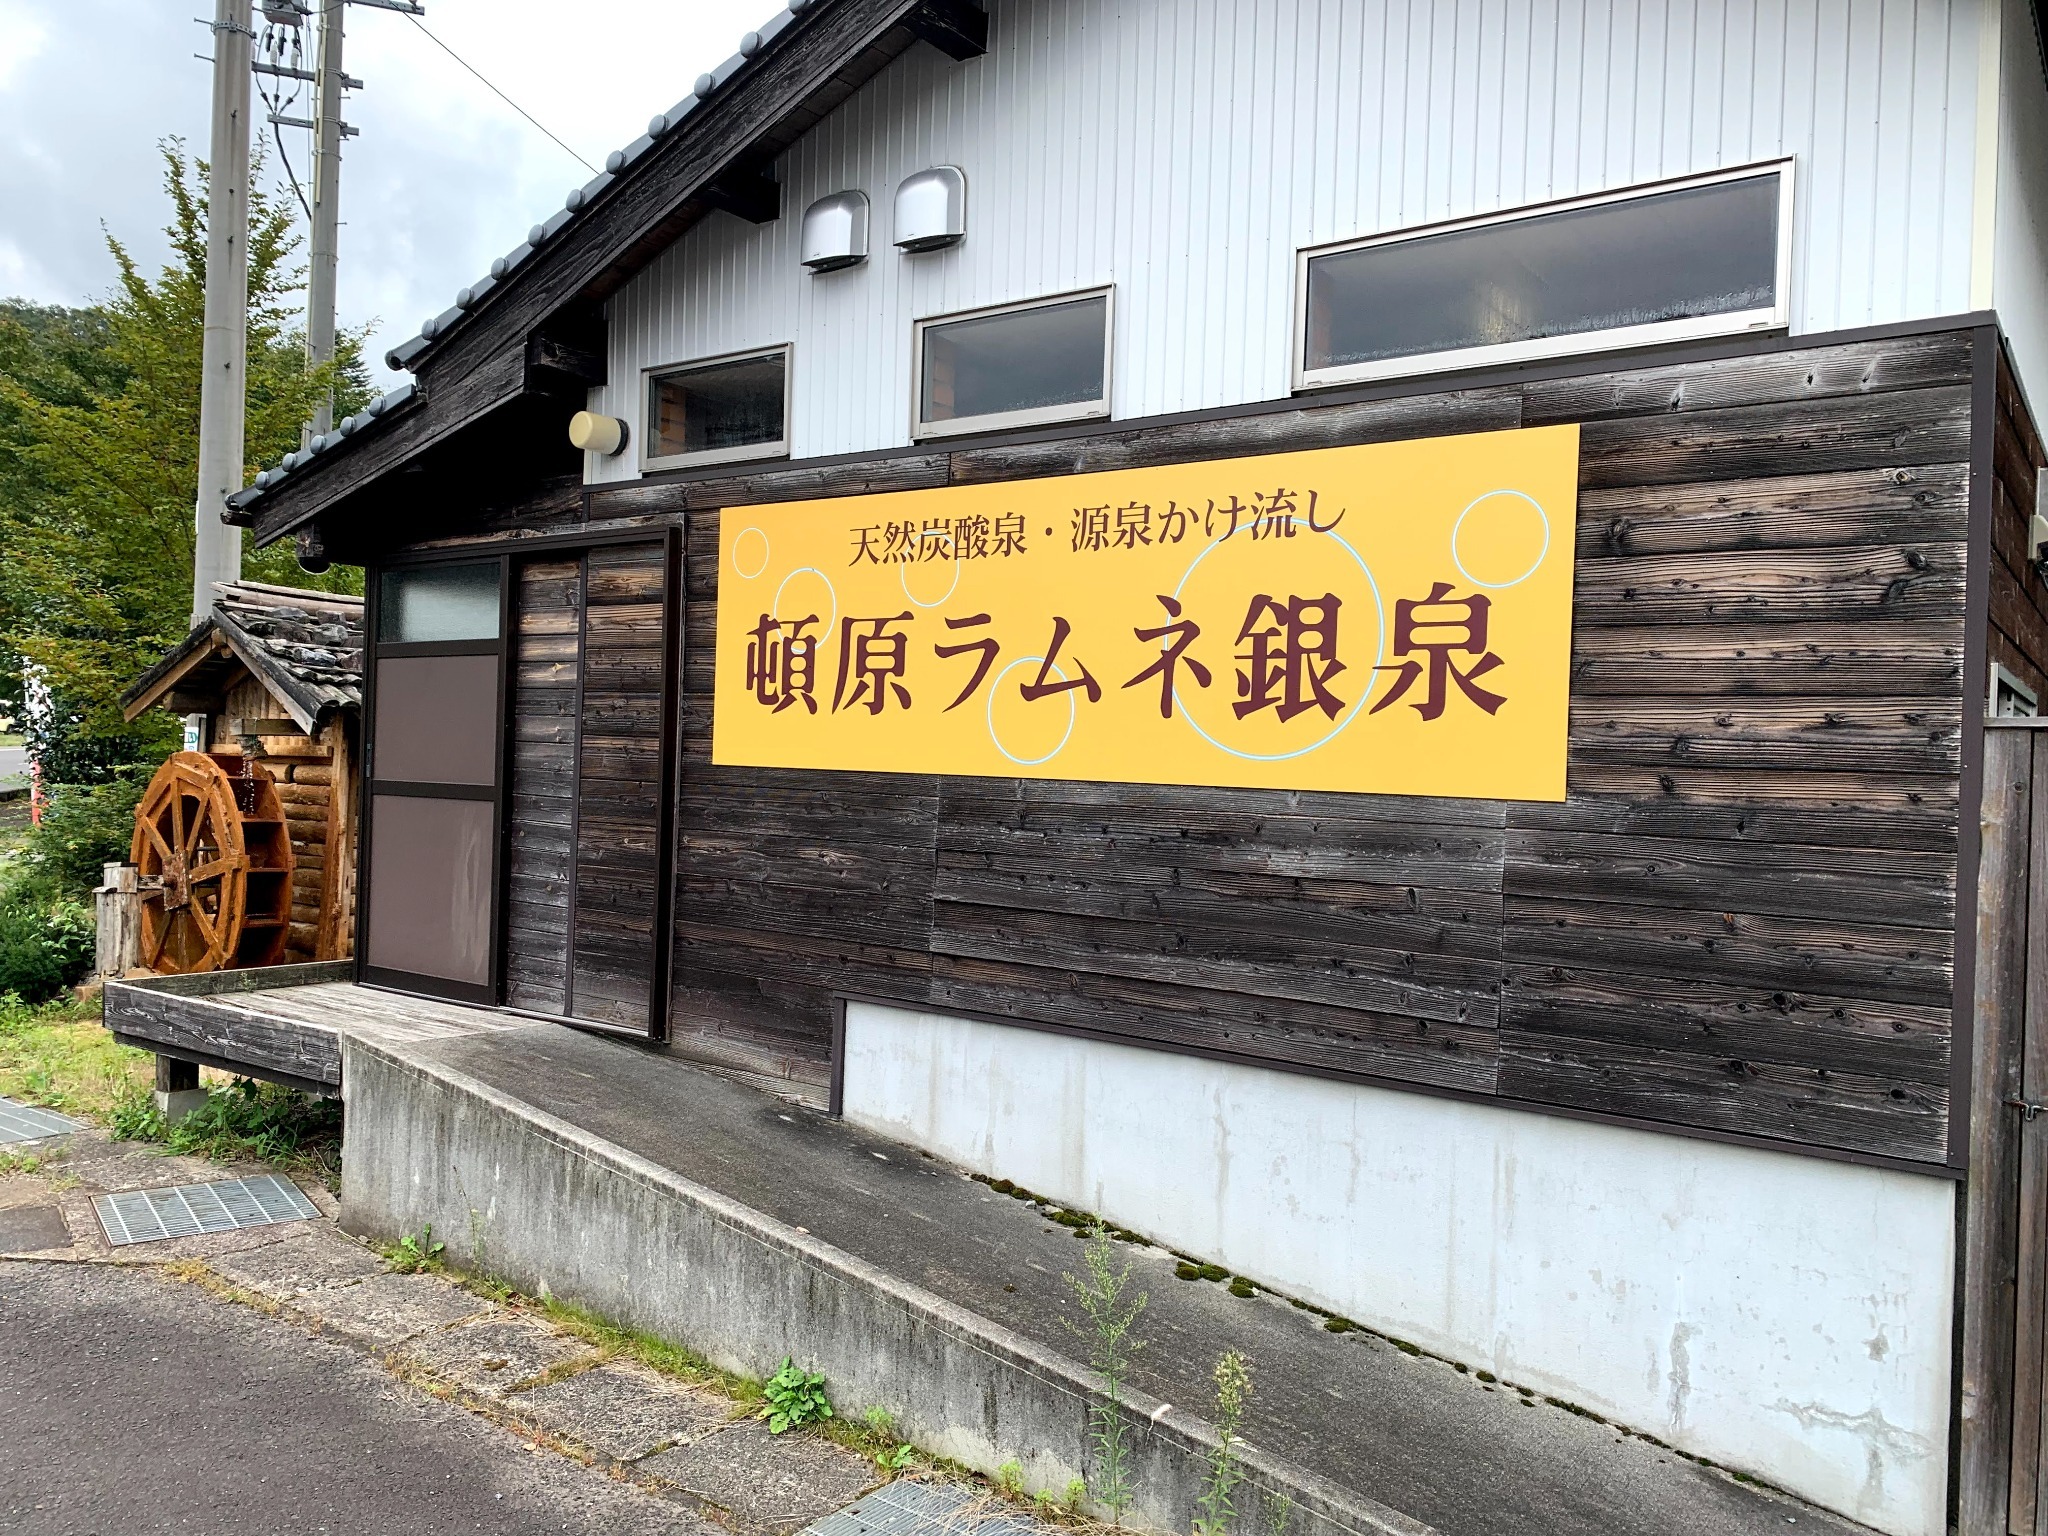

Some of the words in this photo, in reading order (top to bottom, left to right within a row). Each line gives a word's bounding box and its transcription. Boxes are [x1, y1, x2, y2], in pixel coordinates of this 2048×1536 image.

[848, 487, 1347, 567] 天然炭酸泉・源泉かけ流し
[746, 582, 1508, 724] 頓原ラムネ銀泉
